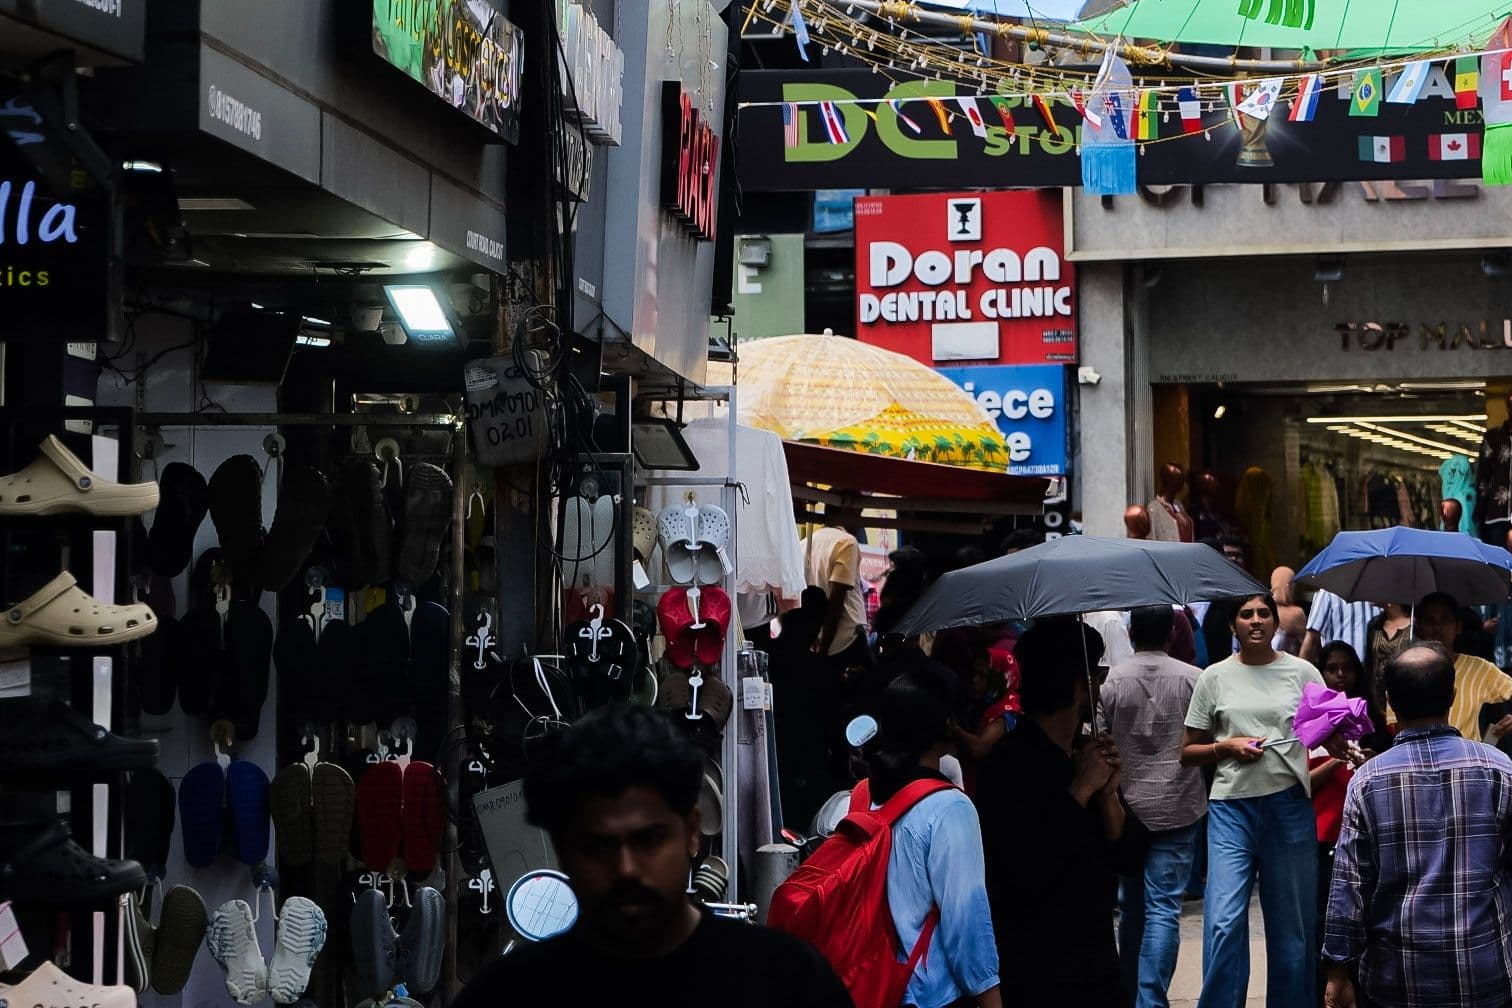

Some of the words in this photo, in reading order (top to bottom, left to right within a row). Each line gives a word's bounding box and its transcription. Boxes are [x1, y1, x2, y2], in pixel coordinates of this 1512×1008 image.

[783, 80, 958, 162] DC
[984, 125, 1082, 157] STO
[869, 241, 1060, 288] Doran
[859, 289, 972, 323] DENTAL
[979, 286, 1071, 318] CLINIC
[1334, 320, 1410, 352] TOP
